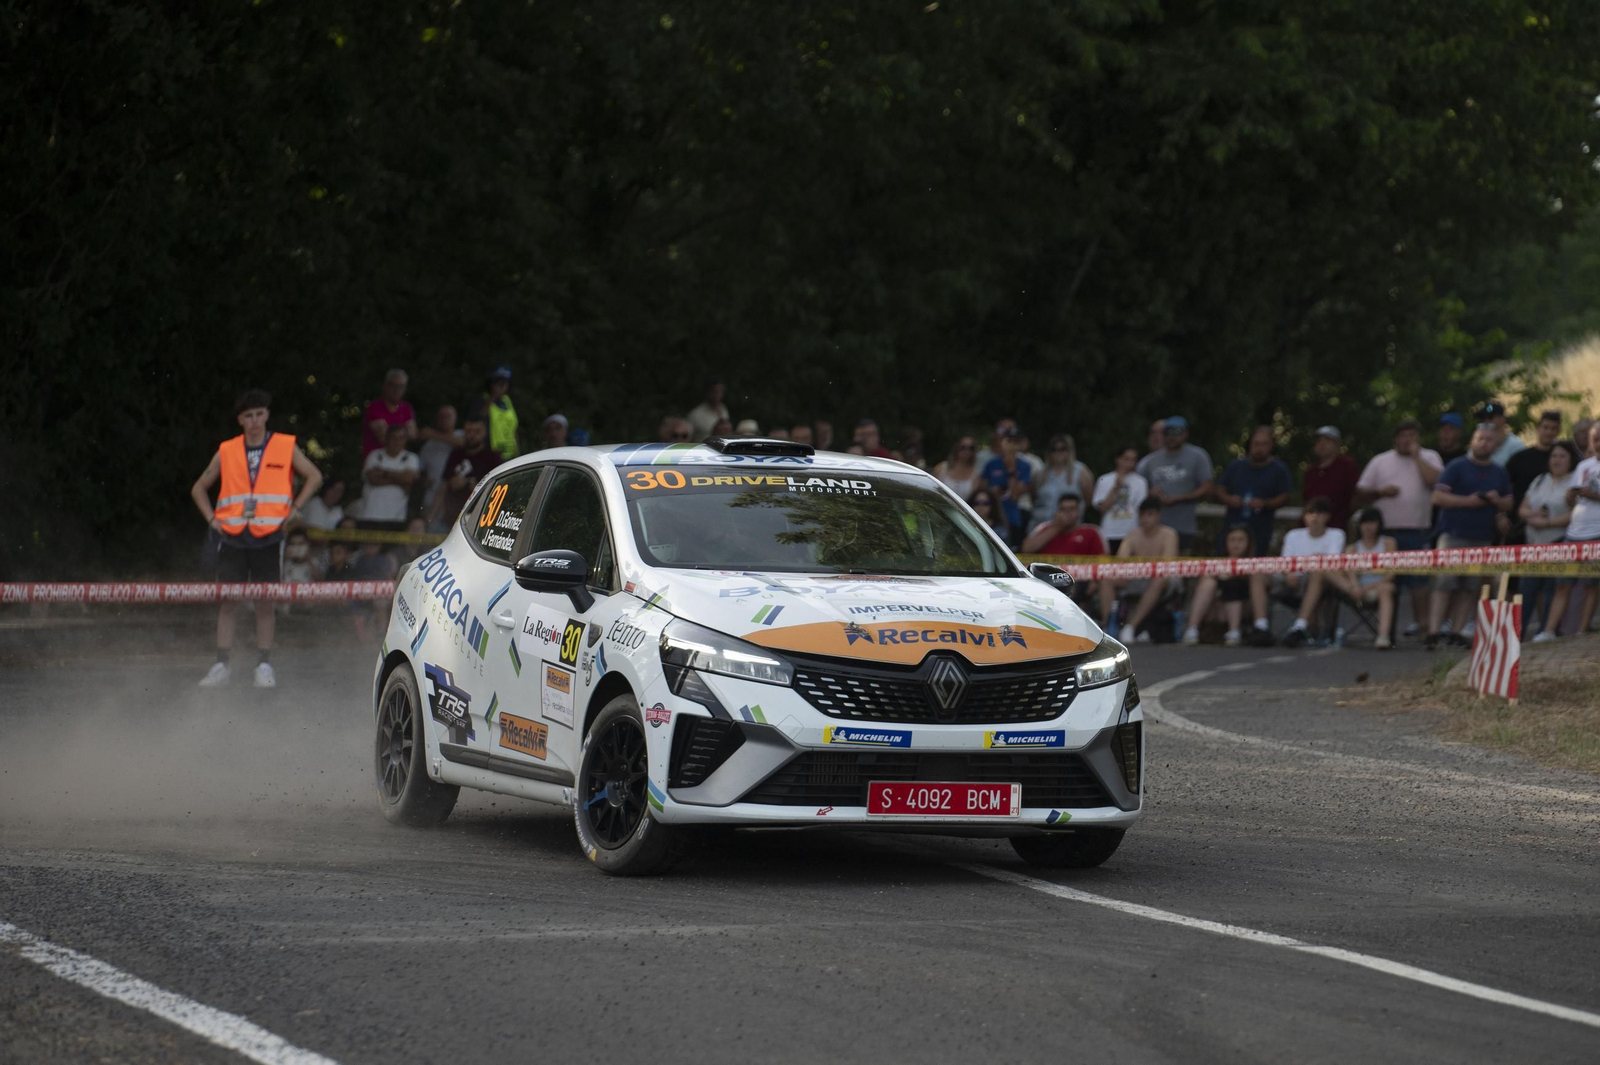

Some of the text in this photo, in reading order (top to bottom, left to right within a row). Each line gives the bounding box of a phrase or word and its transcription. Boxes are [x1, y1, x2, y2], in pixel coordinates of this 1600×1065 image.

[625, 470, 872, 491] 30 DRIVELAND
[788, 486, 877, 496] MOTORSPORT
[479, 484, 508, 528] 30
[535, 558, 571, 566] TRS
[1486, 548, 1515, 564] ZONA
[1520, 544, 1578, 563] PROHIBIDO
[418, 548, 470, 637] BOYACA
[848, 603, 986, 620] IMPERVELPER
[523, 616, 534, 635] La
[431, 603, 485, 678] RECICLAJE
[561, 624, 582, 662] 30
[877, 628, 997, 648] Recalvi
[438, 689, 467, 718] TRS
[508, 720, 539, 752] Recalvi
[848, 732, 903, 743] MICHELIN
[1007, 735, 1058, 744] MICHELIN
[881, 788, 1001, 810] S 4092 BCM
